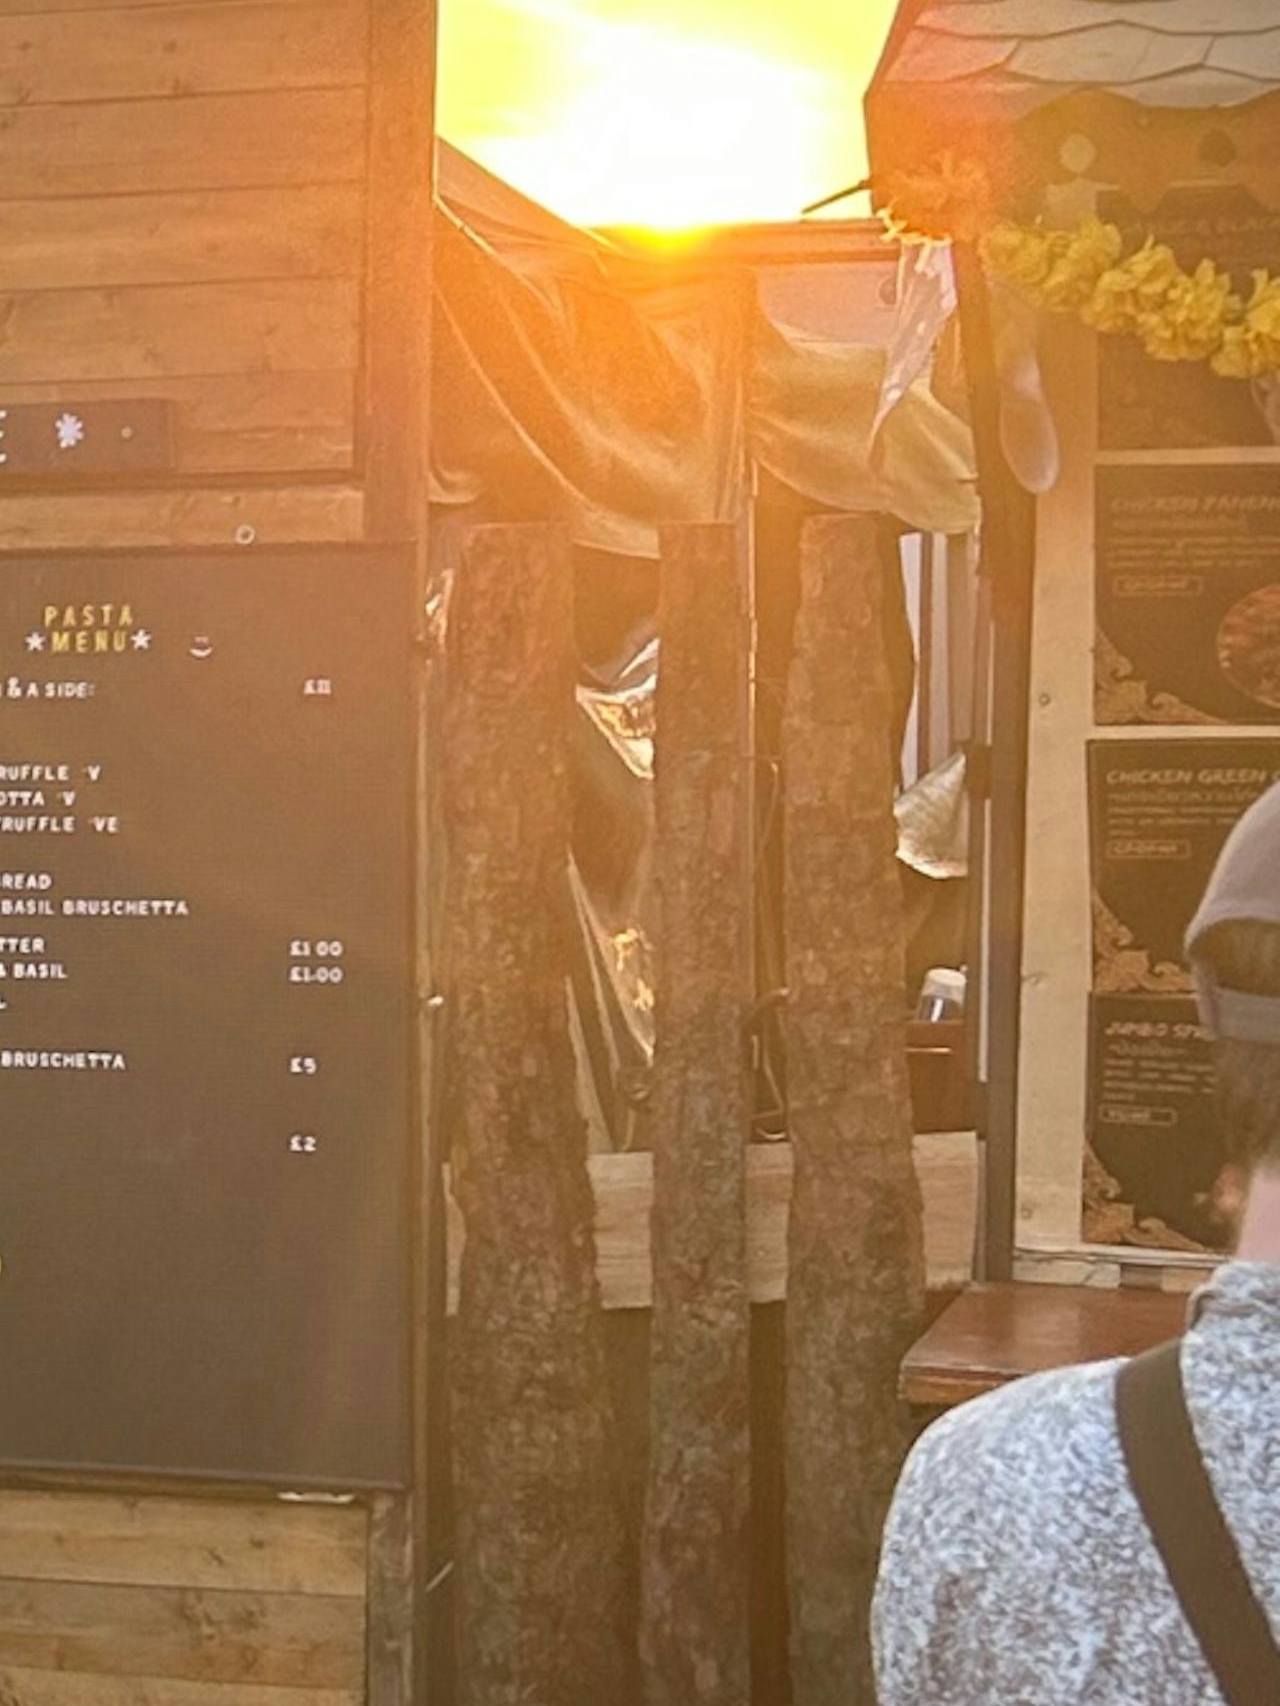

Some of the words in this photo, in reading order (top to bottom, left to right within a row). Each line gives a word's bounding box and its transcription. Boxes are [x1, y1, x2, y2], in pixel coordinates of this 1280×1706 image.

[44, 605, 135, 628] PASTA
[51, 630, 129, 653] MENU
[8, 677, 22, 698] &
[26, 683, 39, 697] A
[1, 901, 55, 916] BASIL
[62, 900, 189, 916] BRUSCHETTA
[14, 963, 68, 979] BASIL
[1, 1051, 126, 1069] BRUSCHETTA
